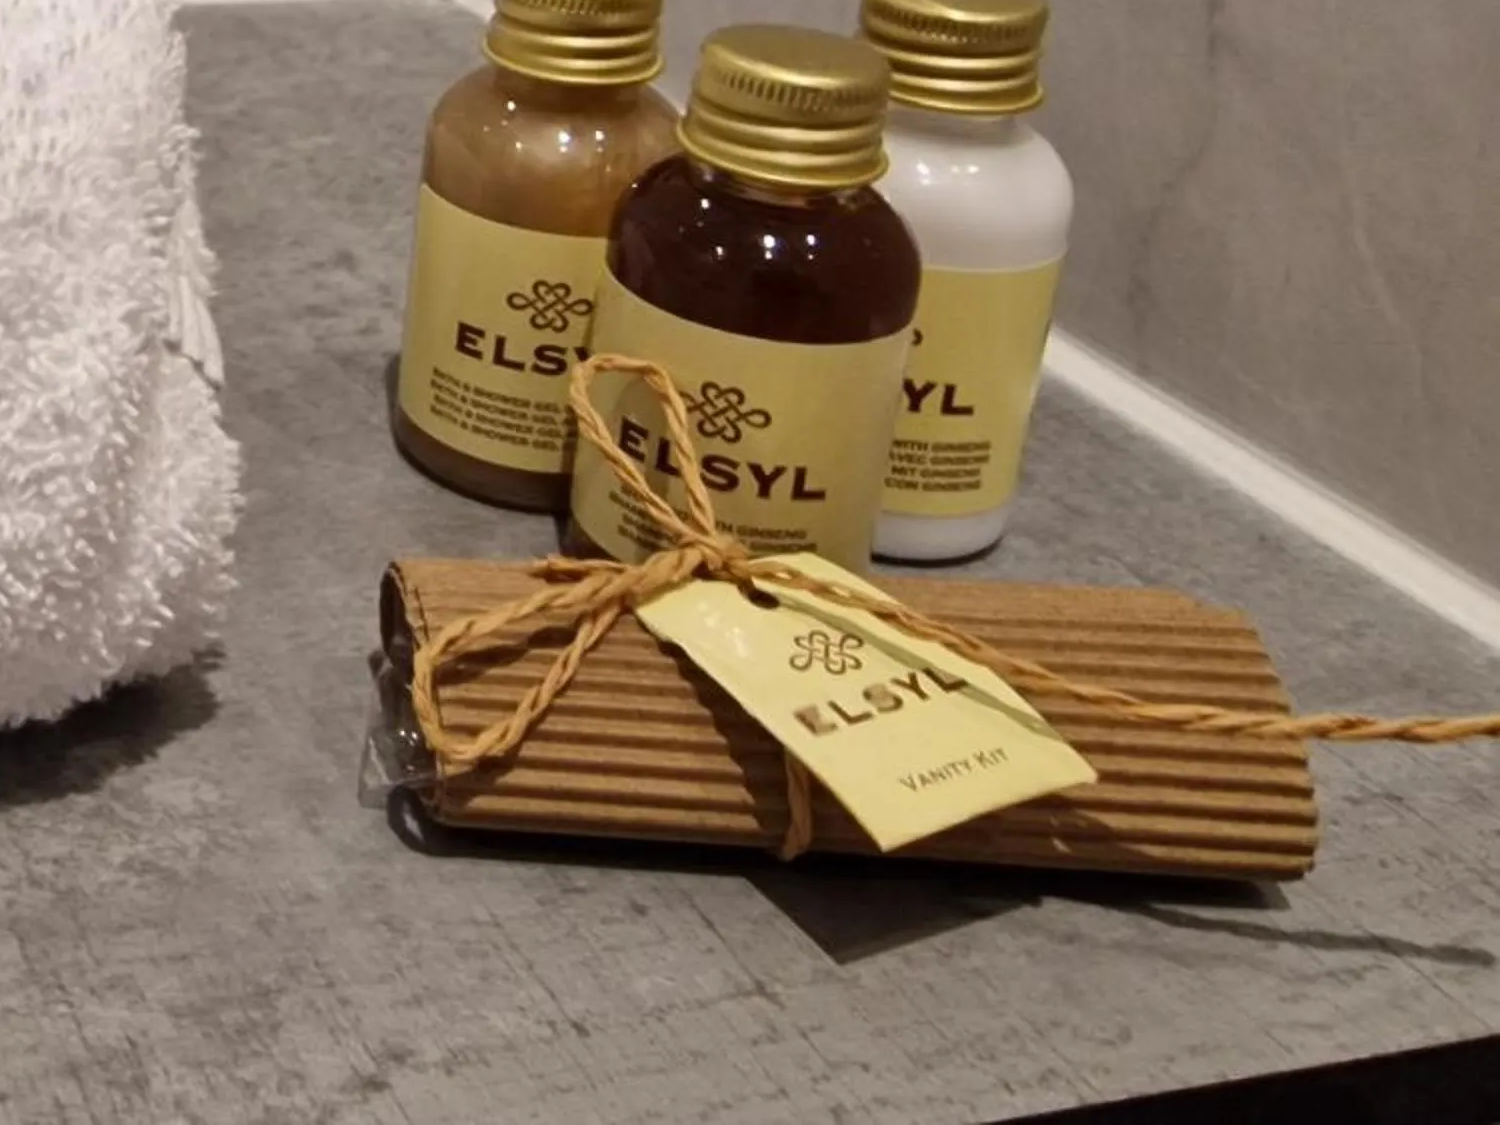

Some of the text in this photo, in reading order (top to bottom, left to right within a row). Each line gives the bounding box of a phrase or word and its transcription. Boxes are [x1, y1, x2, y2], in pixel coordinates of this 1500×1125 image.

[455, 321, 590, 376] ELS
[619, 414, 826, 500] ELSYL
[794, 667, 969, 736] ELSYL
